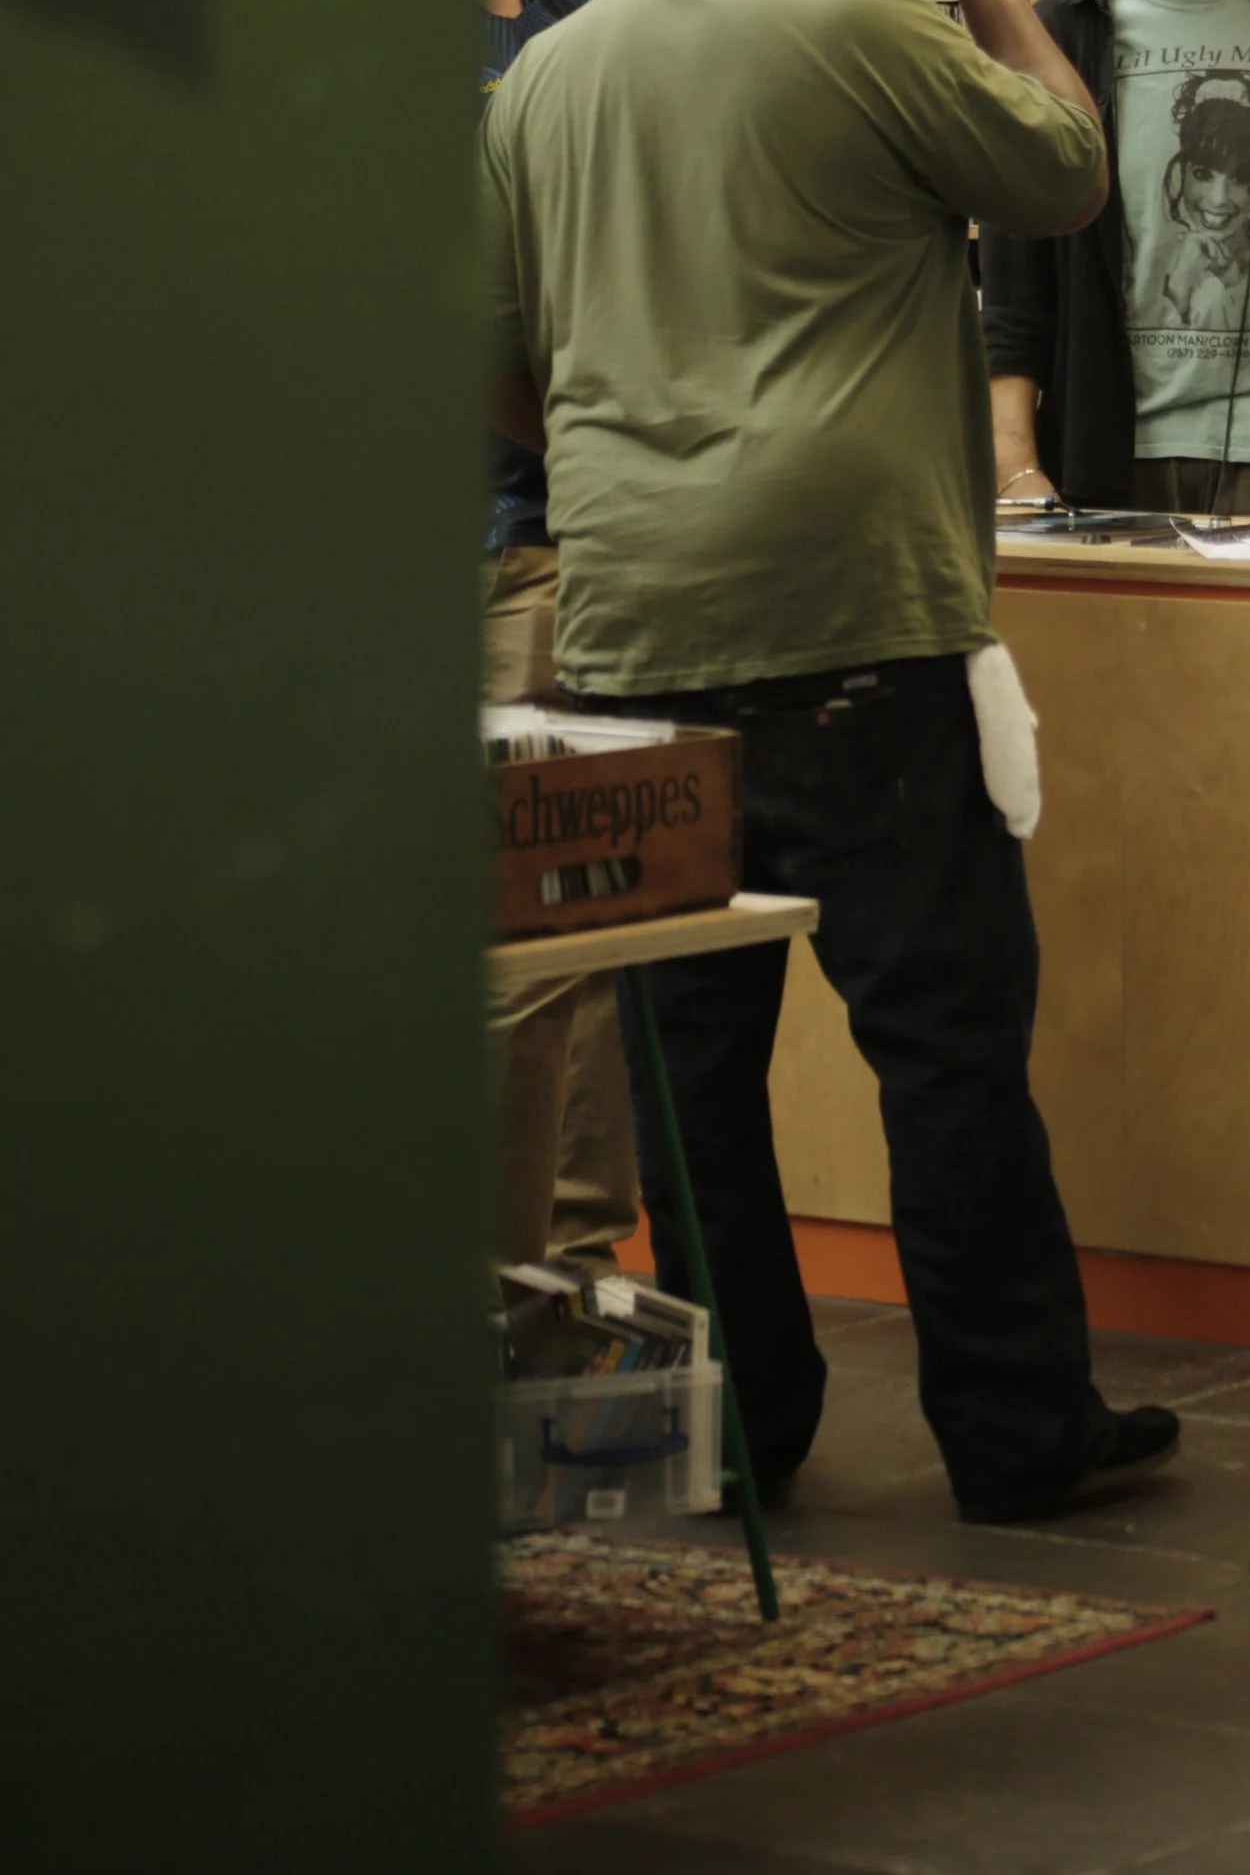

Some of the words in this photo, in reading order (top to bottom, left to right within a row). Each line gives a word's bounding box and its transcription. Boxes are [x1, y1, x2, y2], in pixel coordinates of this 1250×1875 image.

[1116, 50, 1150, 70] Lil
[1160, 45, 1222, 68] Ugly
[1128, 333, 1175, 346] RTOON
